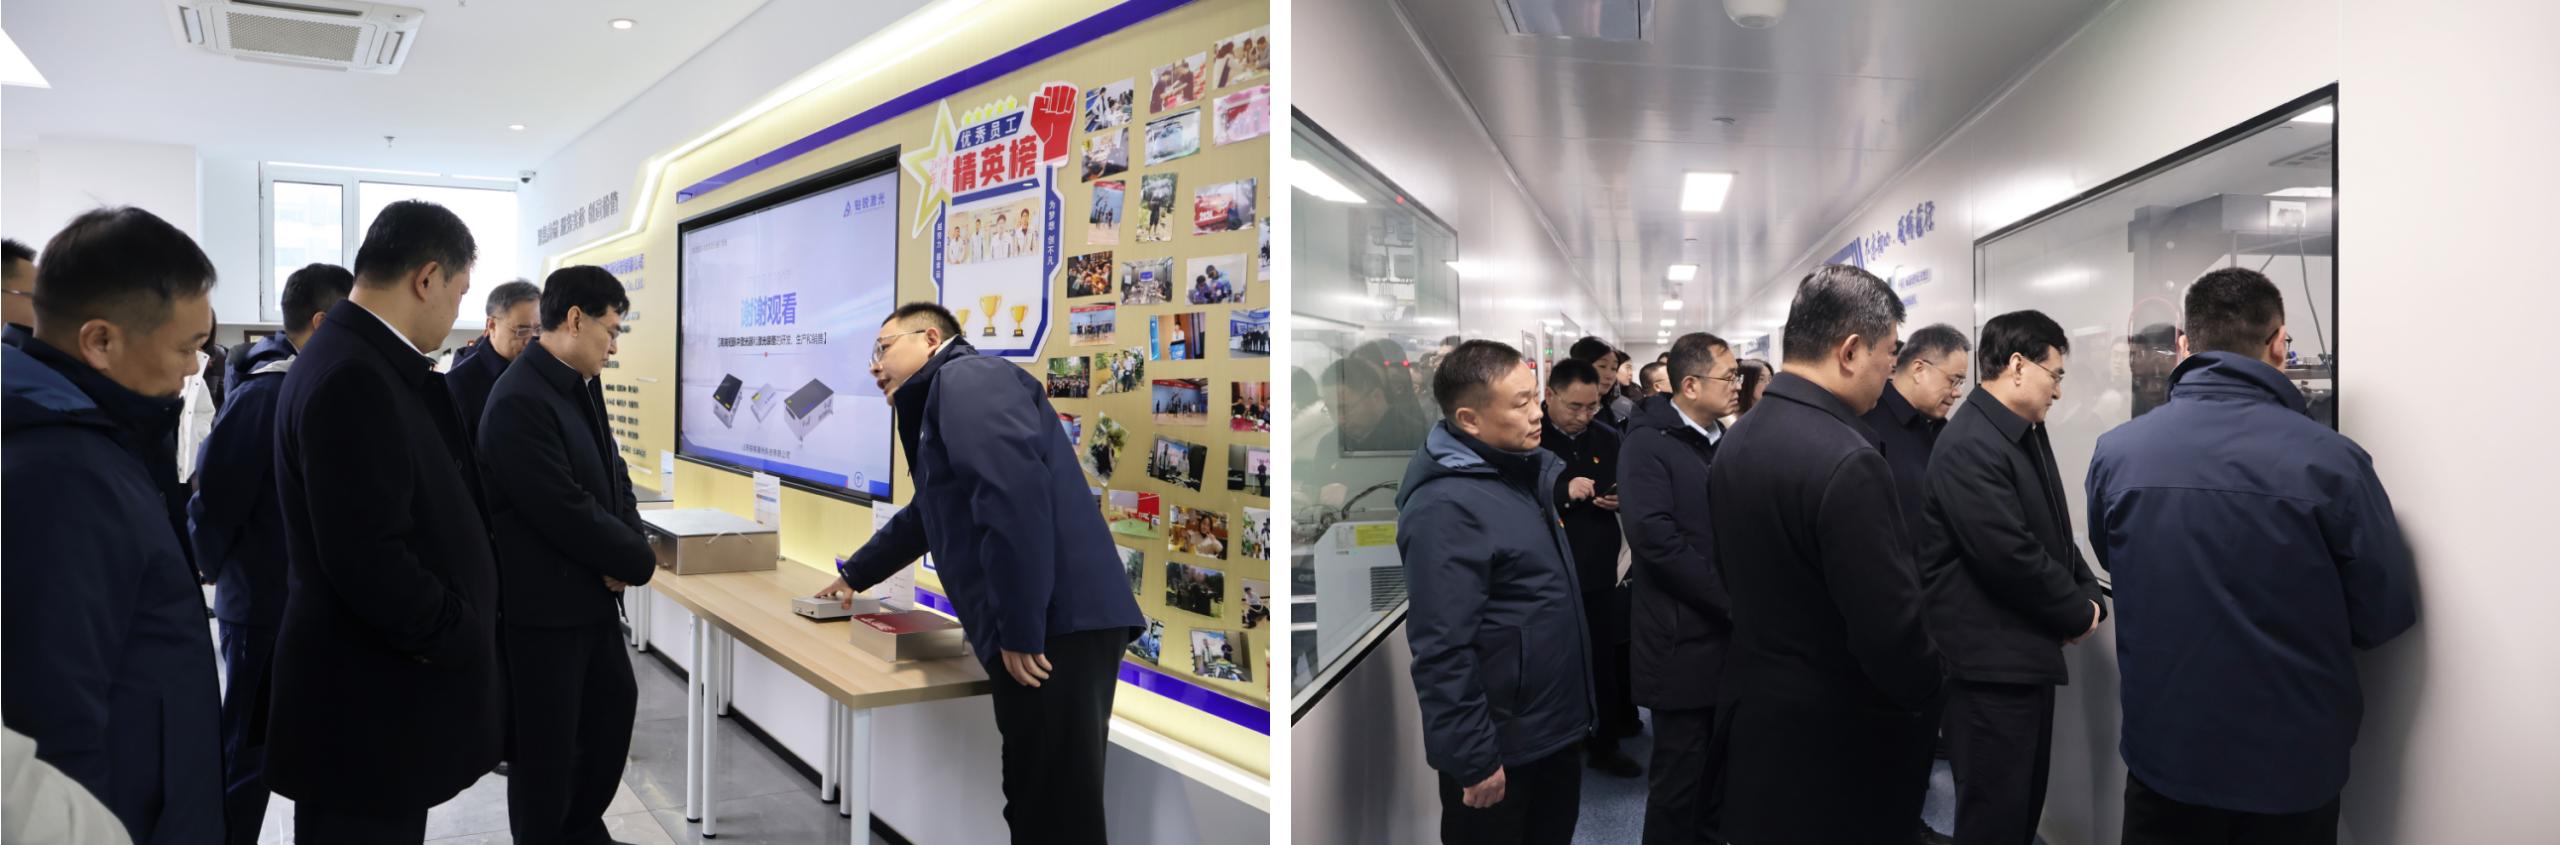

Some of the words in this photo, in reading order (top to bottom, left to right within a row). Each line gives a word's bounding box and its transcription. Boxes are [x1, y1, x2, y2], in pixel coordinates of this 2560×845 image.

[961, 116, 1018, 148] 优秀员工
[952, 135, 1037, 193] 精英榜
[740, 292, 797, 328] 谢谢观看
